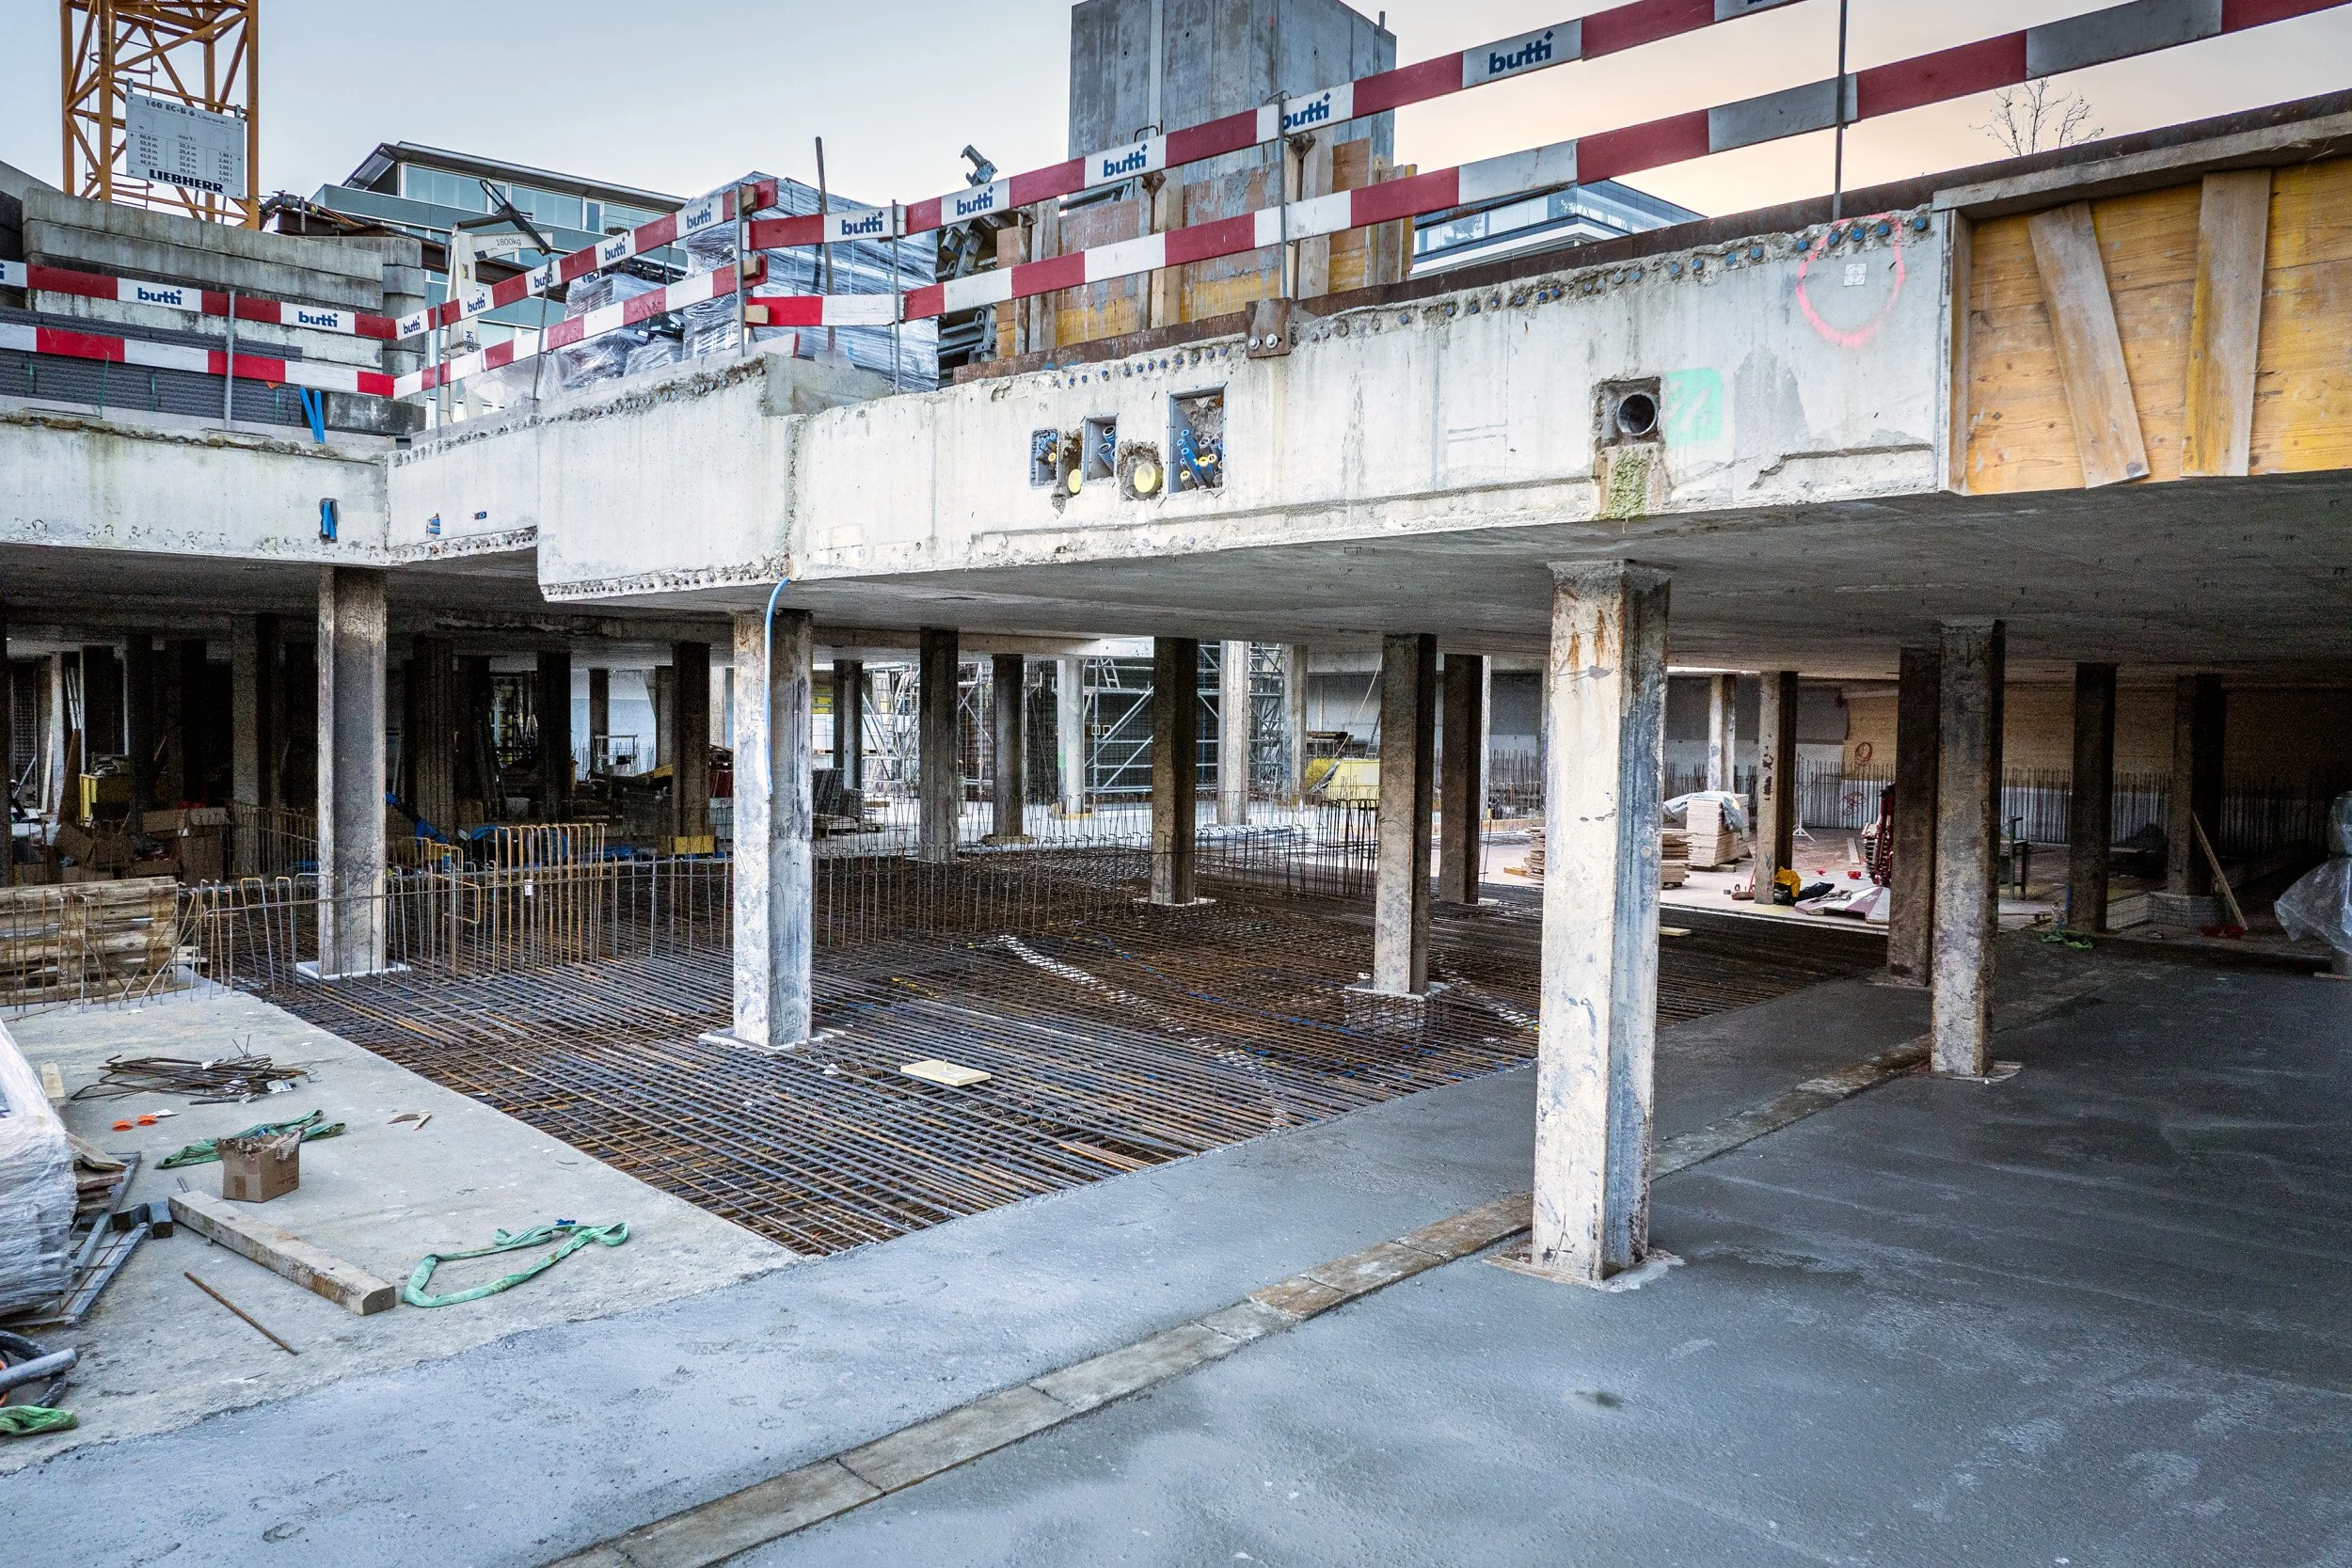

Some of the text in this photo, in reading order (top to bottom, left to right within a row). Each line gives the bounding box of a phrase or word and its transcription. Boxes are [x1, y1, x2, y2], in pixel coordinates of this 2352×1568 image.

[1488, 30, 1554, 75] butti
[145, 99, 162, 109] 160
[165, 103, 186, 114] EC-B
[1103, 143, 1148, 178] butti
[149, 169, 224, 193] LIEBHERR
[956, 185, 994, 216] butti
[687, 202, 712, 230] butti
[841, 210, 884, 235] butti
[496, 238, 521, 246] 1800kg
[604, 237, 626, 261] butti
[534, 266, 553, 288] buti
[137, 287, 182, 305] butti
[467, 292, 485, 313] butti
[299, 311, 338, 327] butti
[403, 315, 420, 334] butti
